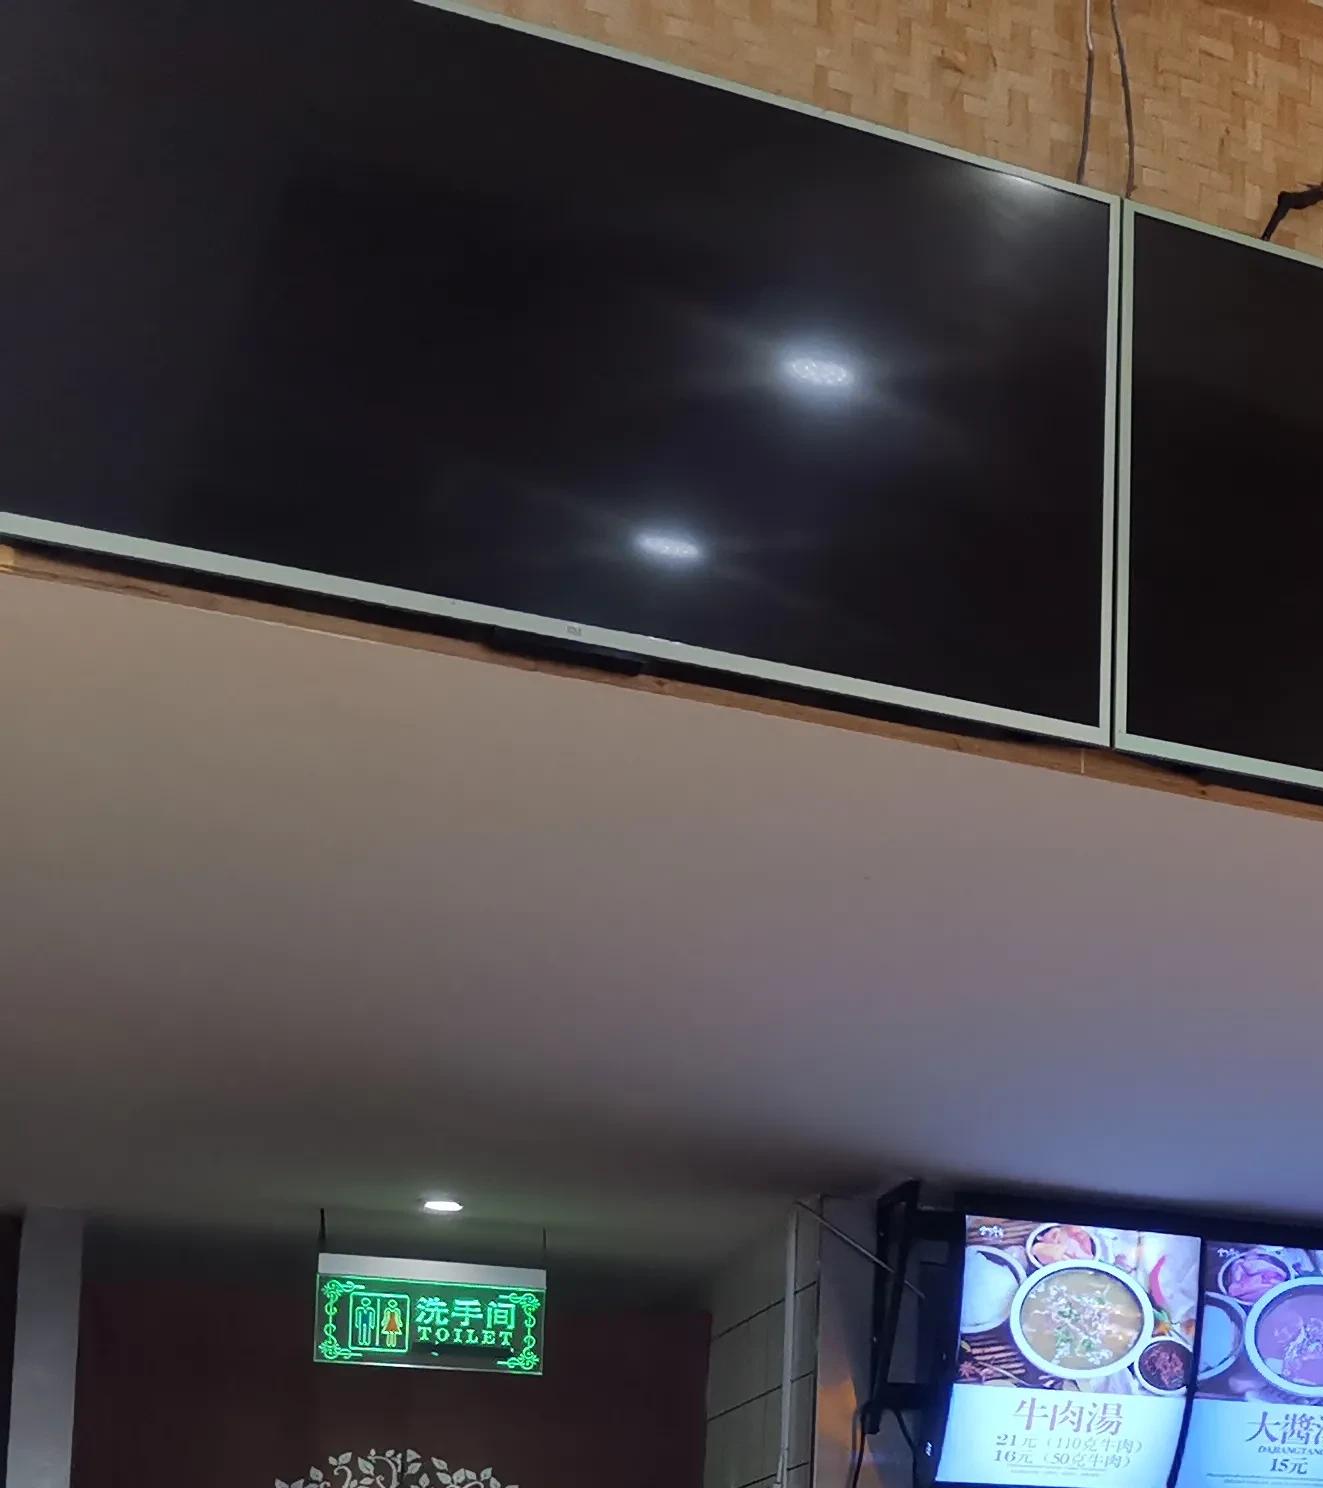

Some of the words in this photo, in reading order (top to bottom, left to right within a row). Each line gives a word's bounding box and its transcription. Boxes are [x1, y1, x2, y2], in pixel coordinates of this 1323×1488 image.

[415, 1296, 517, 1329] 洗手间
[417, 1326, 514, 1346] TOILET
[1269, 1457, 1309, 1475] 15元
